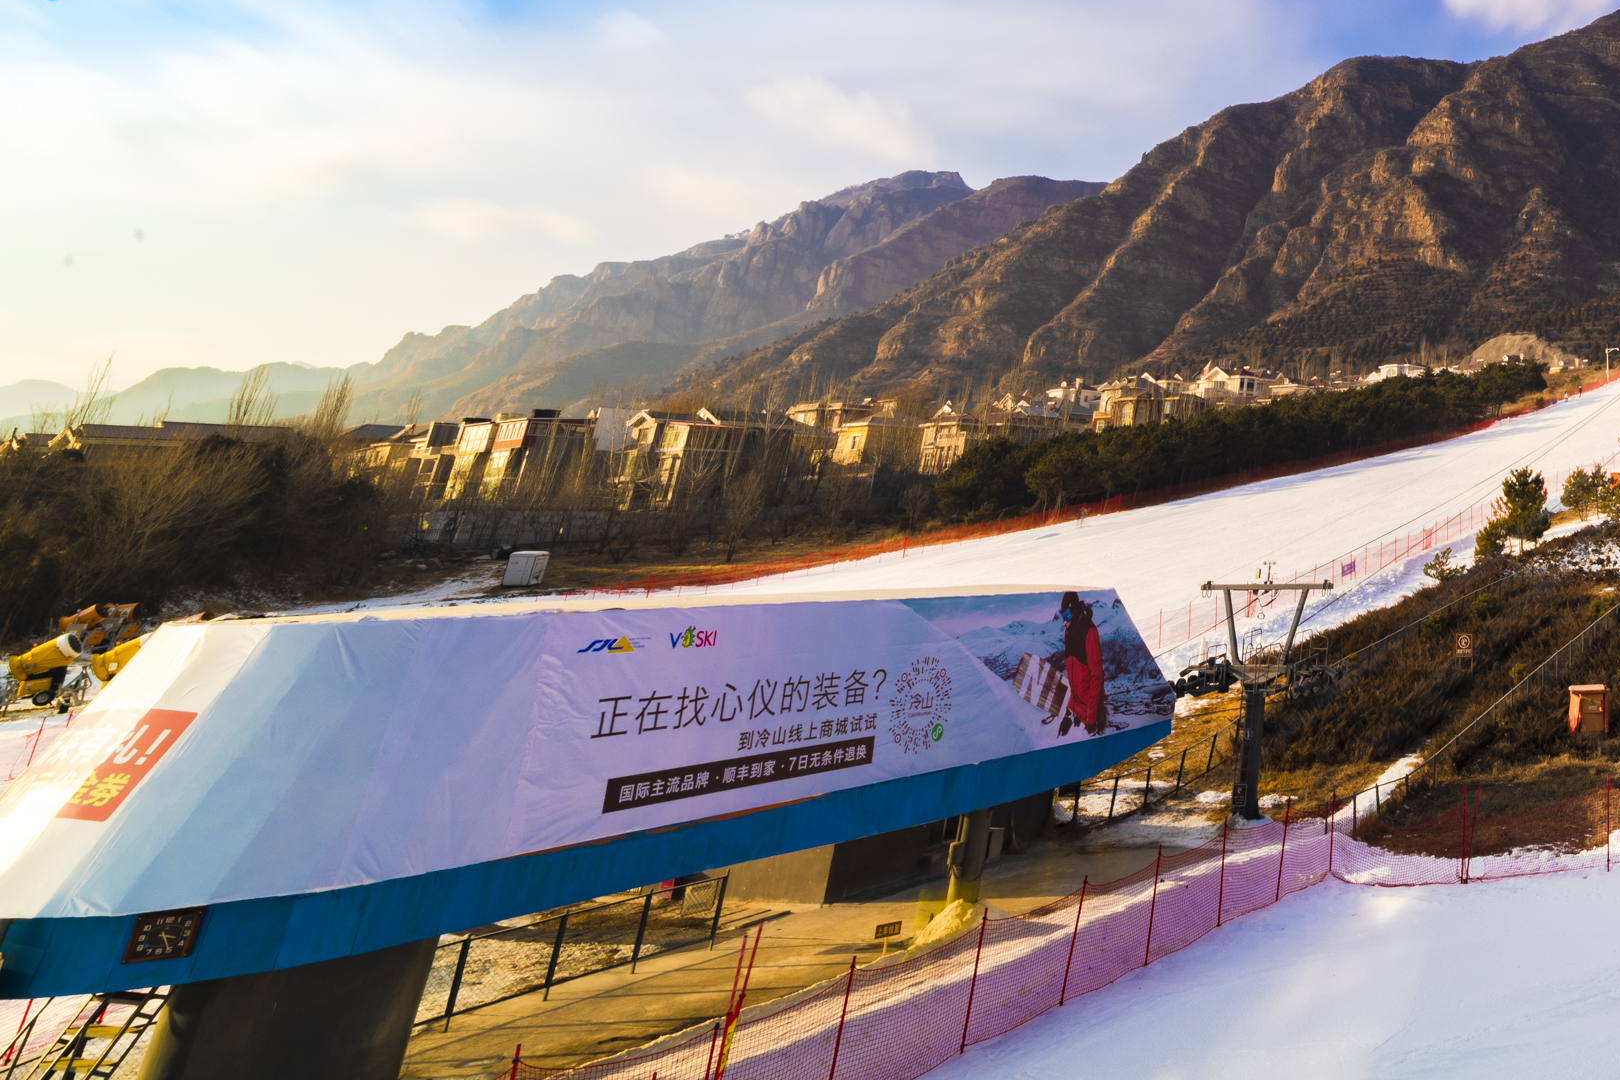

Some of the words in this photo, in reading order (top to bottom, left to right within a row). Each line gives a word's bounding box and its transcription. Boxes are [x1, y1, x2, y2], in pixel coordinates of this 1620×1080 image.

[590, 669, 887, 739] 正在找心仪的装备?
[737, 713, 878, 751] 到冷山线上商城试试
